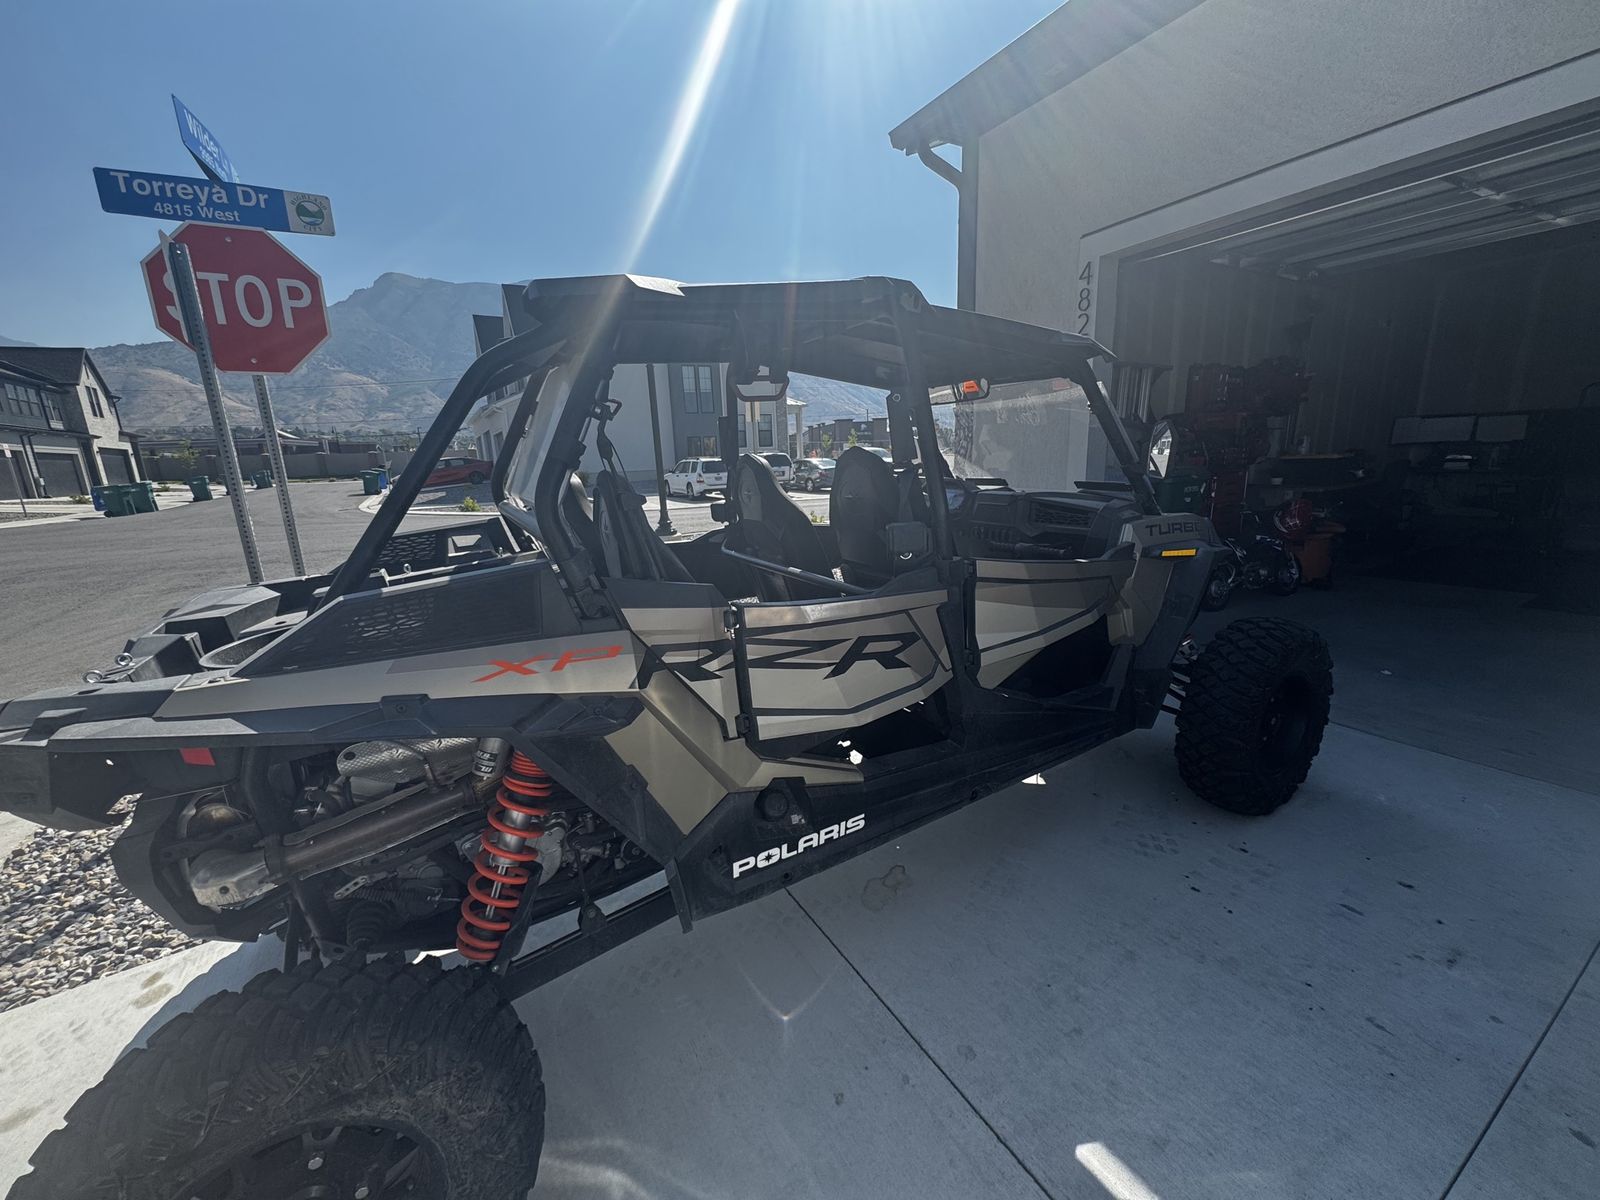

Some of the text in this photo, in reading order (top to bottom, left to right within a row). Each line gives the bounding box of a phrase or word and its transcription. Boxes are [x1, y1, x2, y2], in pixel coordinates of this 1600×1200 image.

[110, 171, 269, 208] Torreya Dr
[154, 202, 241, 222] 4815 West
[471, 644, 624, 683] XP
[630, 631, 922, 690] RZR
[732, 813, 866, 879] POLARIS
